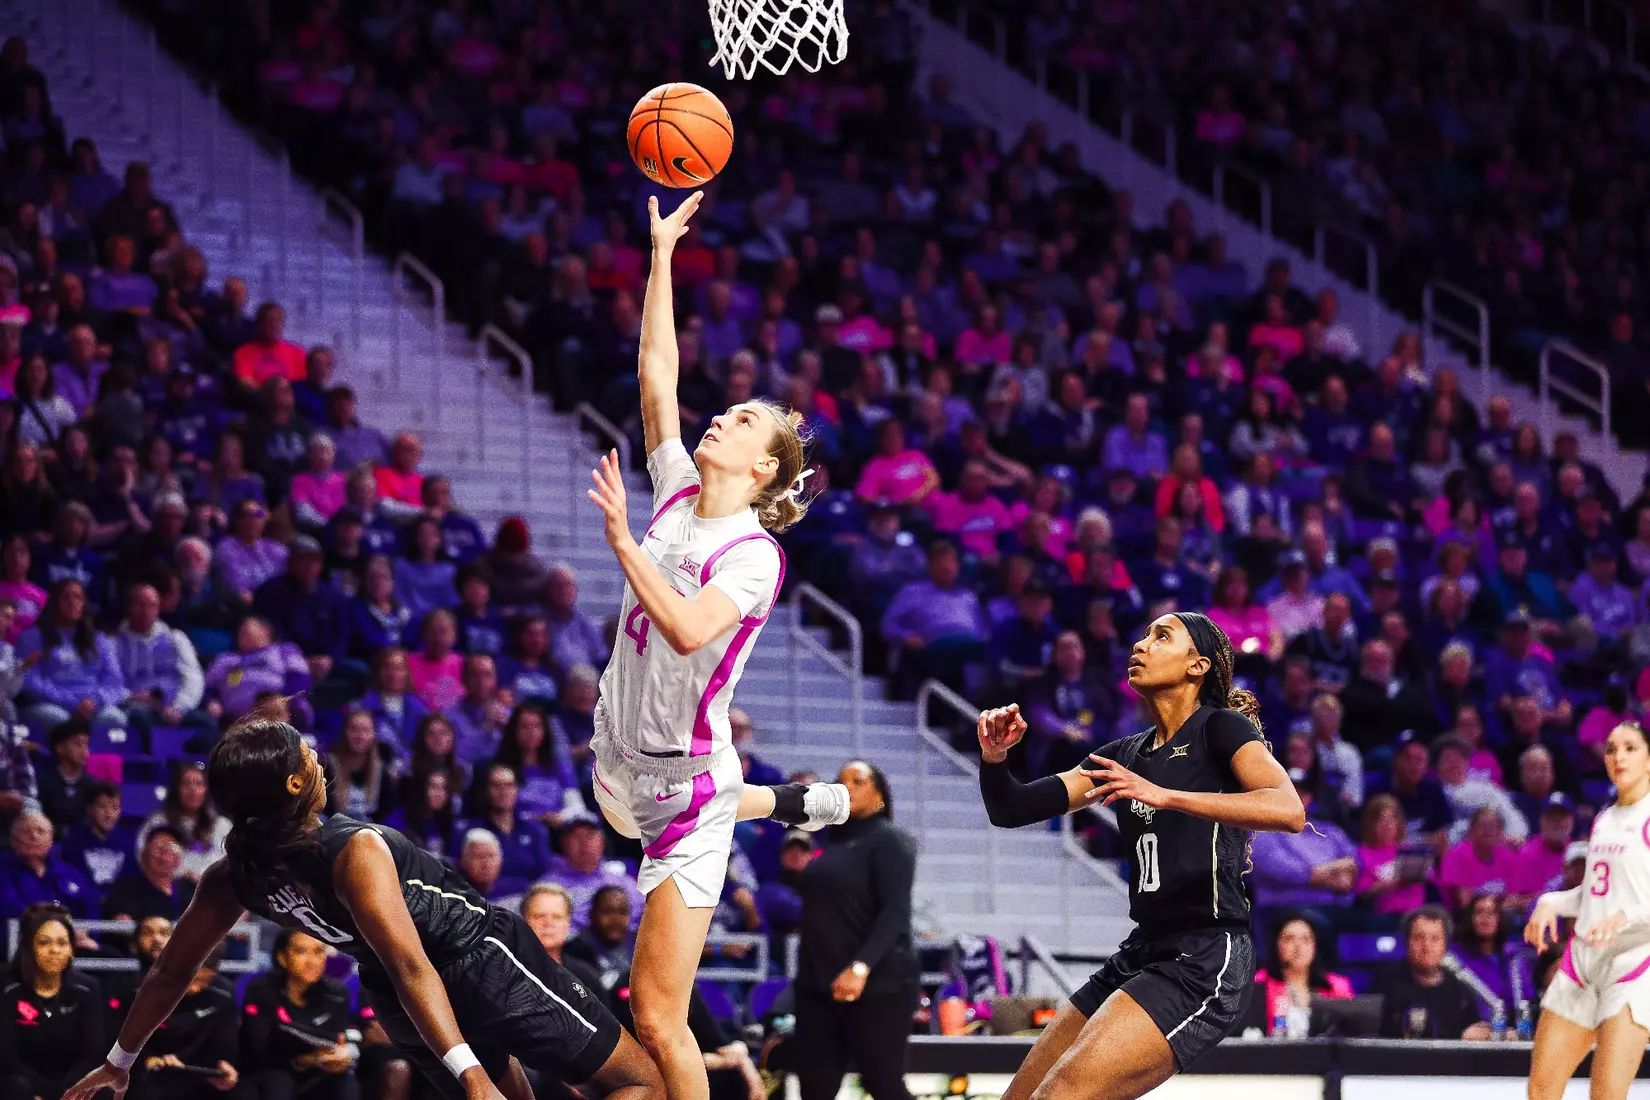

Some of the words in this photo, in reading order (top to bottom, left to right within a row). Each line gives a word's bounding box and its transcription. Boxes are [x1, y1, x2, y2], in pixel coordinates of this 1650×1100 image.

[625, 604, 650, 656] 4
[1136, 832, 1161, 893] 10
[1591, 860, 1611, 897] 3
[292, 906, 354, 944] 0
